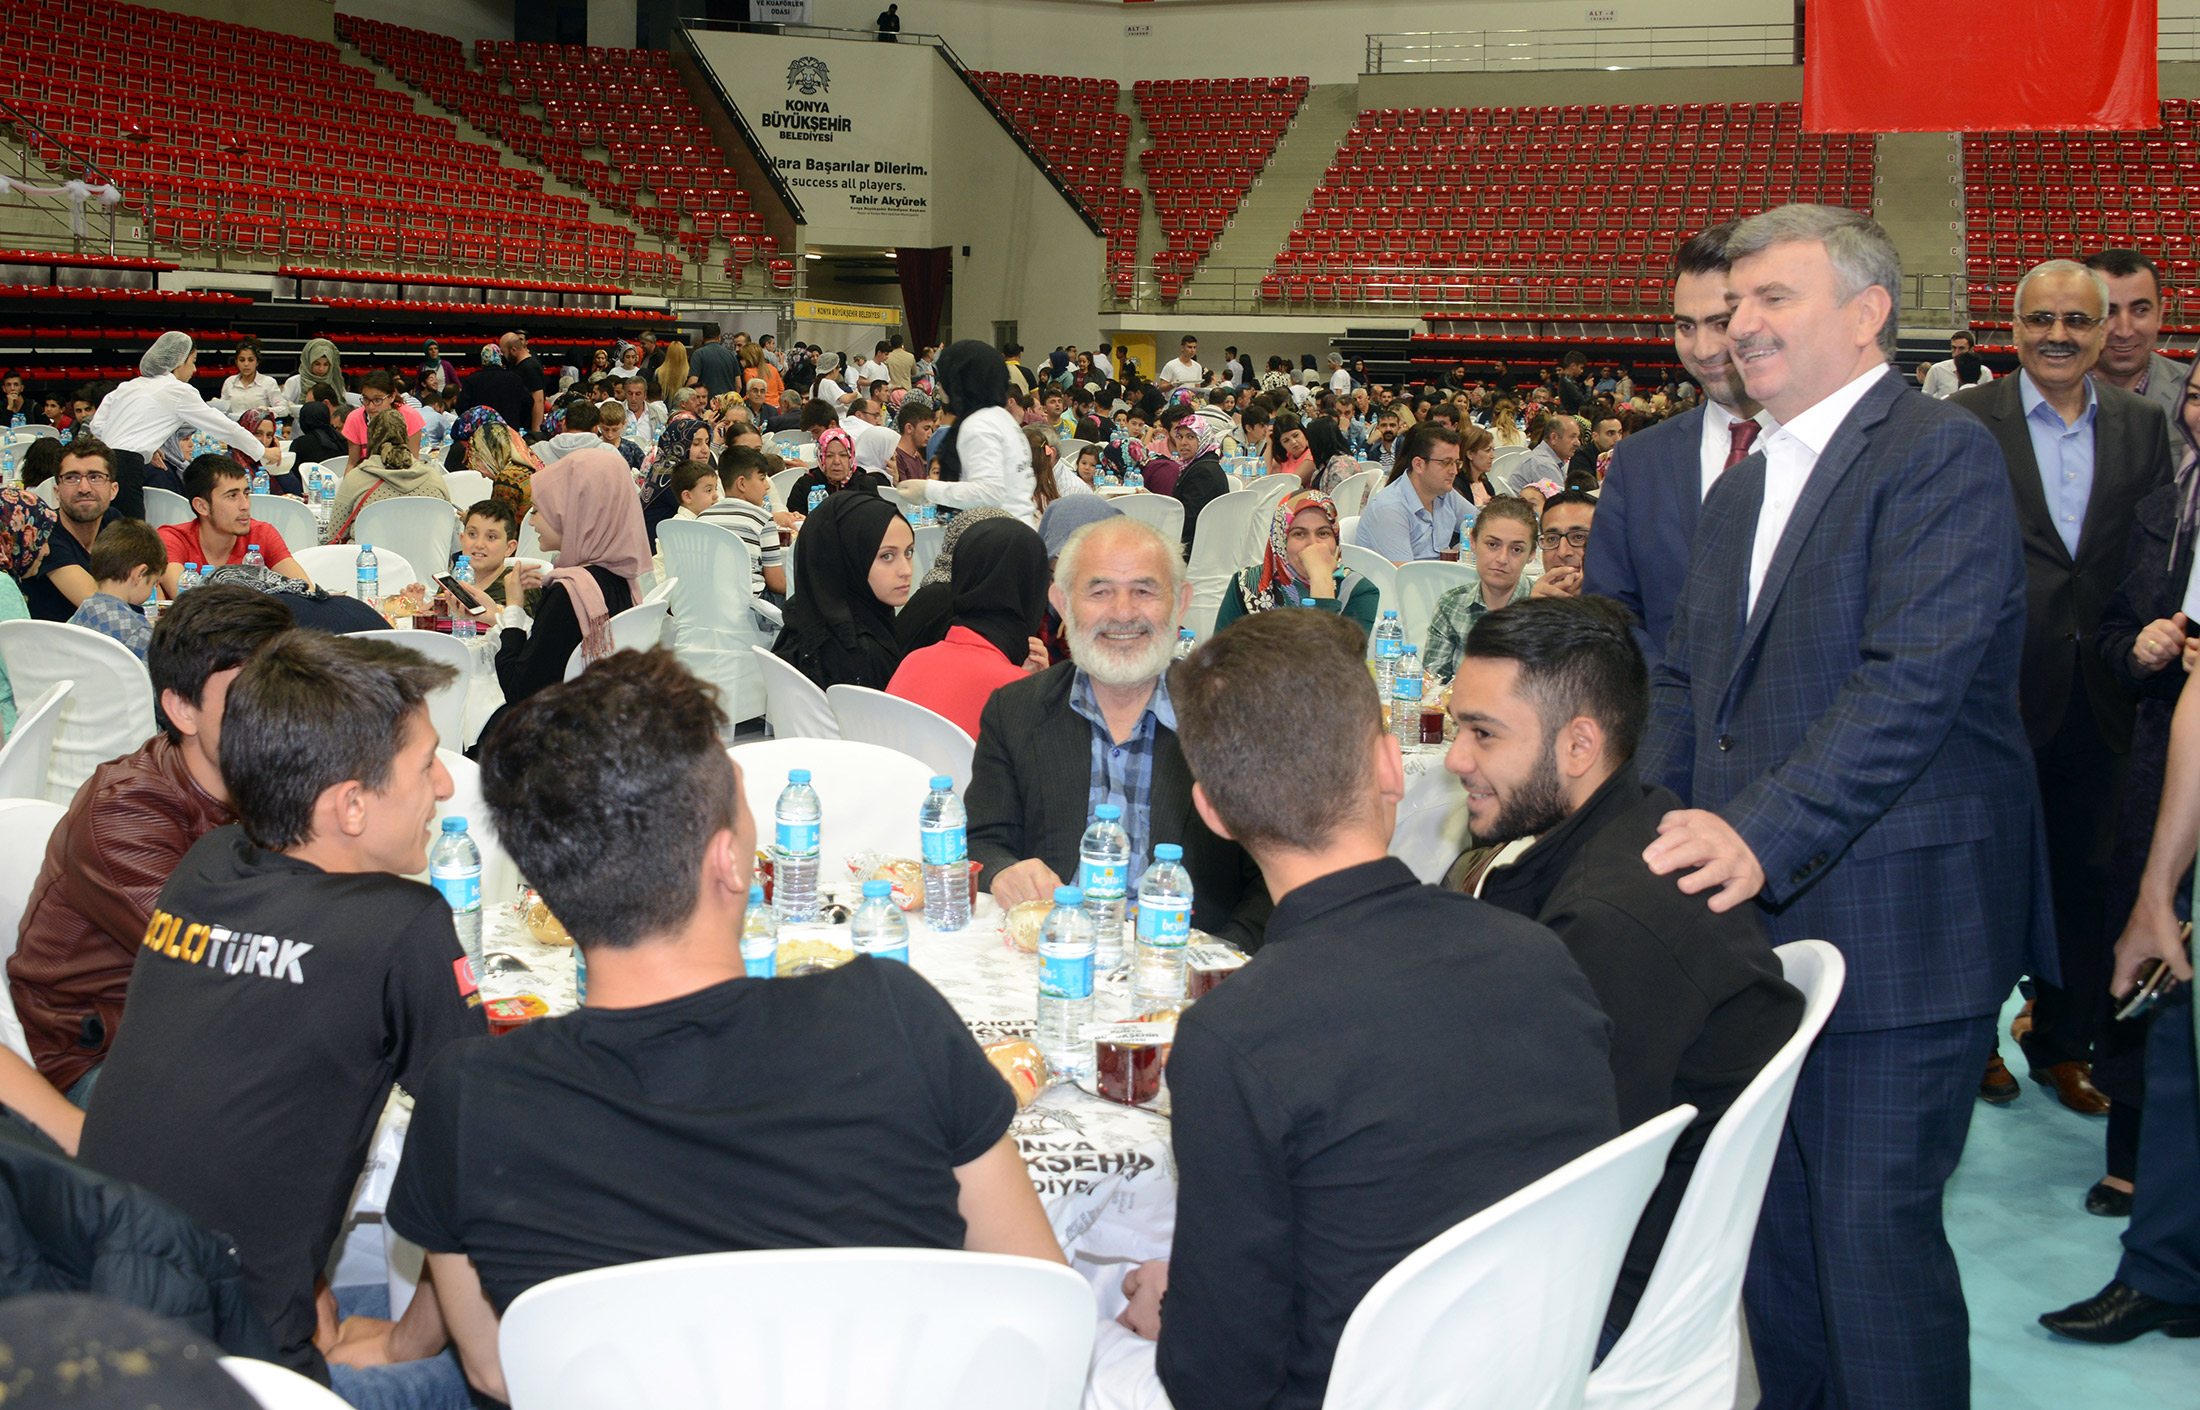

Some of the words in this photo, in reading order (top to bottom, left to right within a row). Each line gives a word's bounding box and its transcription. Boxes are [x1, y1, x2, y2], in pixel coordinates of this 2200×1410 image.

[785, 99, 830, 114] KONYA
[761, 111, 852, 133] BÜYÜKŞEHİR
[779, 131, 834, 143] BELEDİYESİ
[773, 156, 801, 170] lara
[806, 158, 871, 175] Başarılar
[874, 161, 928, 176] Dilerim.
[791, 177, 839, 189] success
[841, 178, 857, 190] all
[859, 179, 906, 193] players.
[849, 194, 878, 205] Tahir
[881, 195, 927, 207] Akyürek
[817, 307, 831, 315] KONYA
